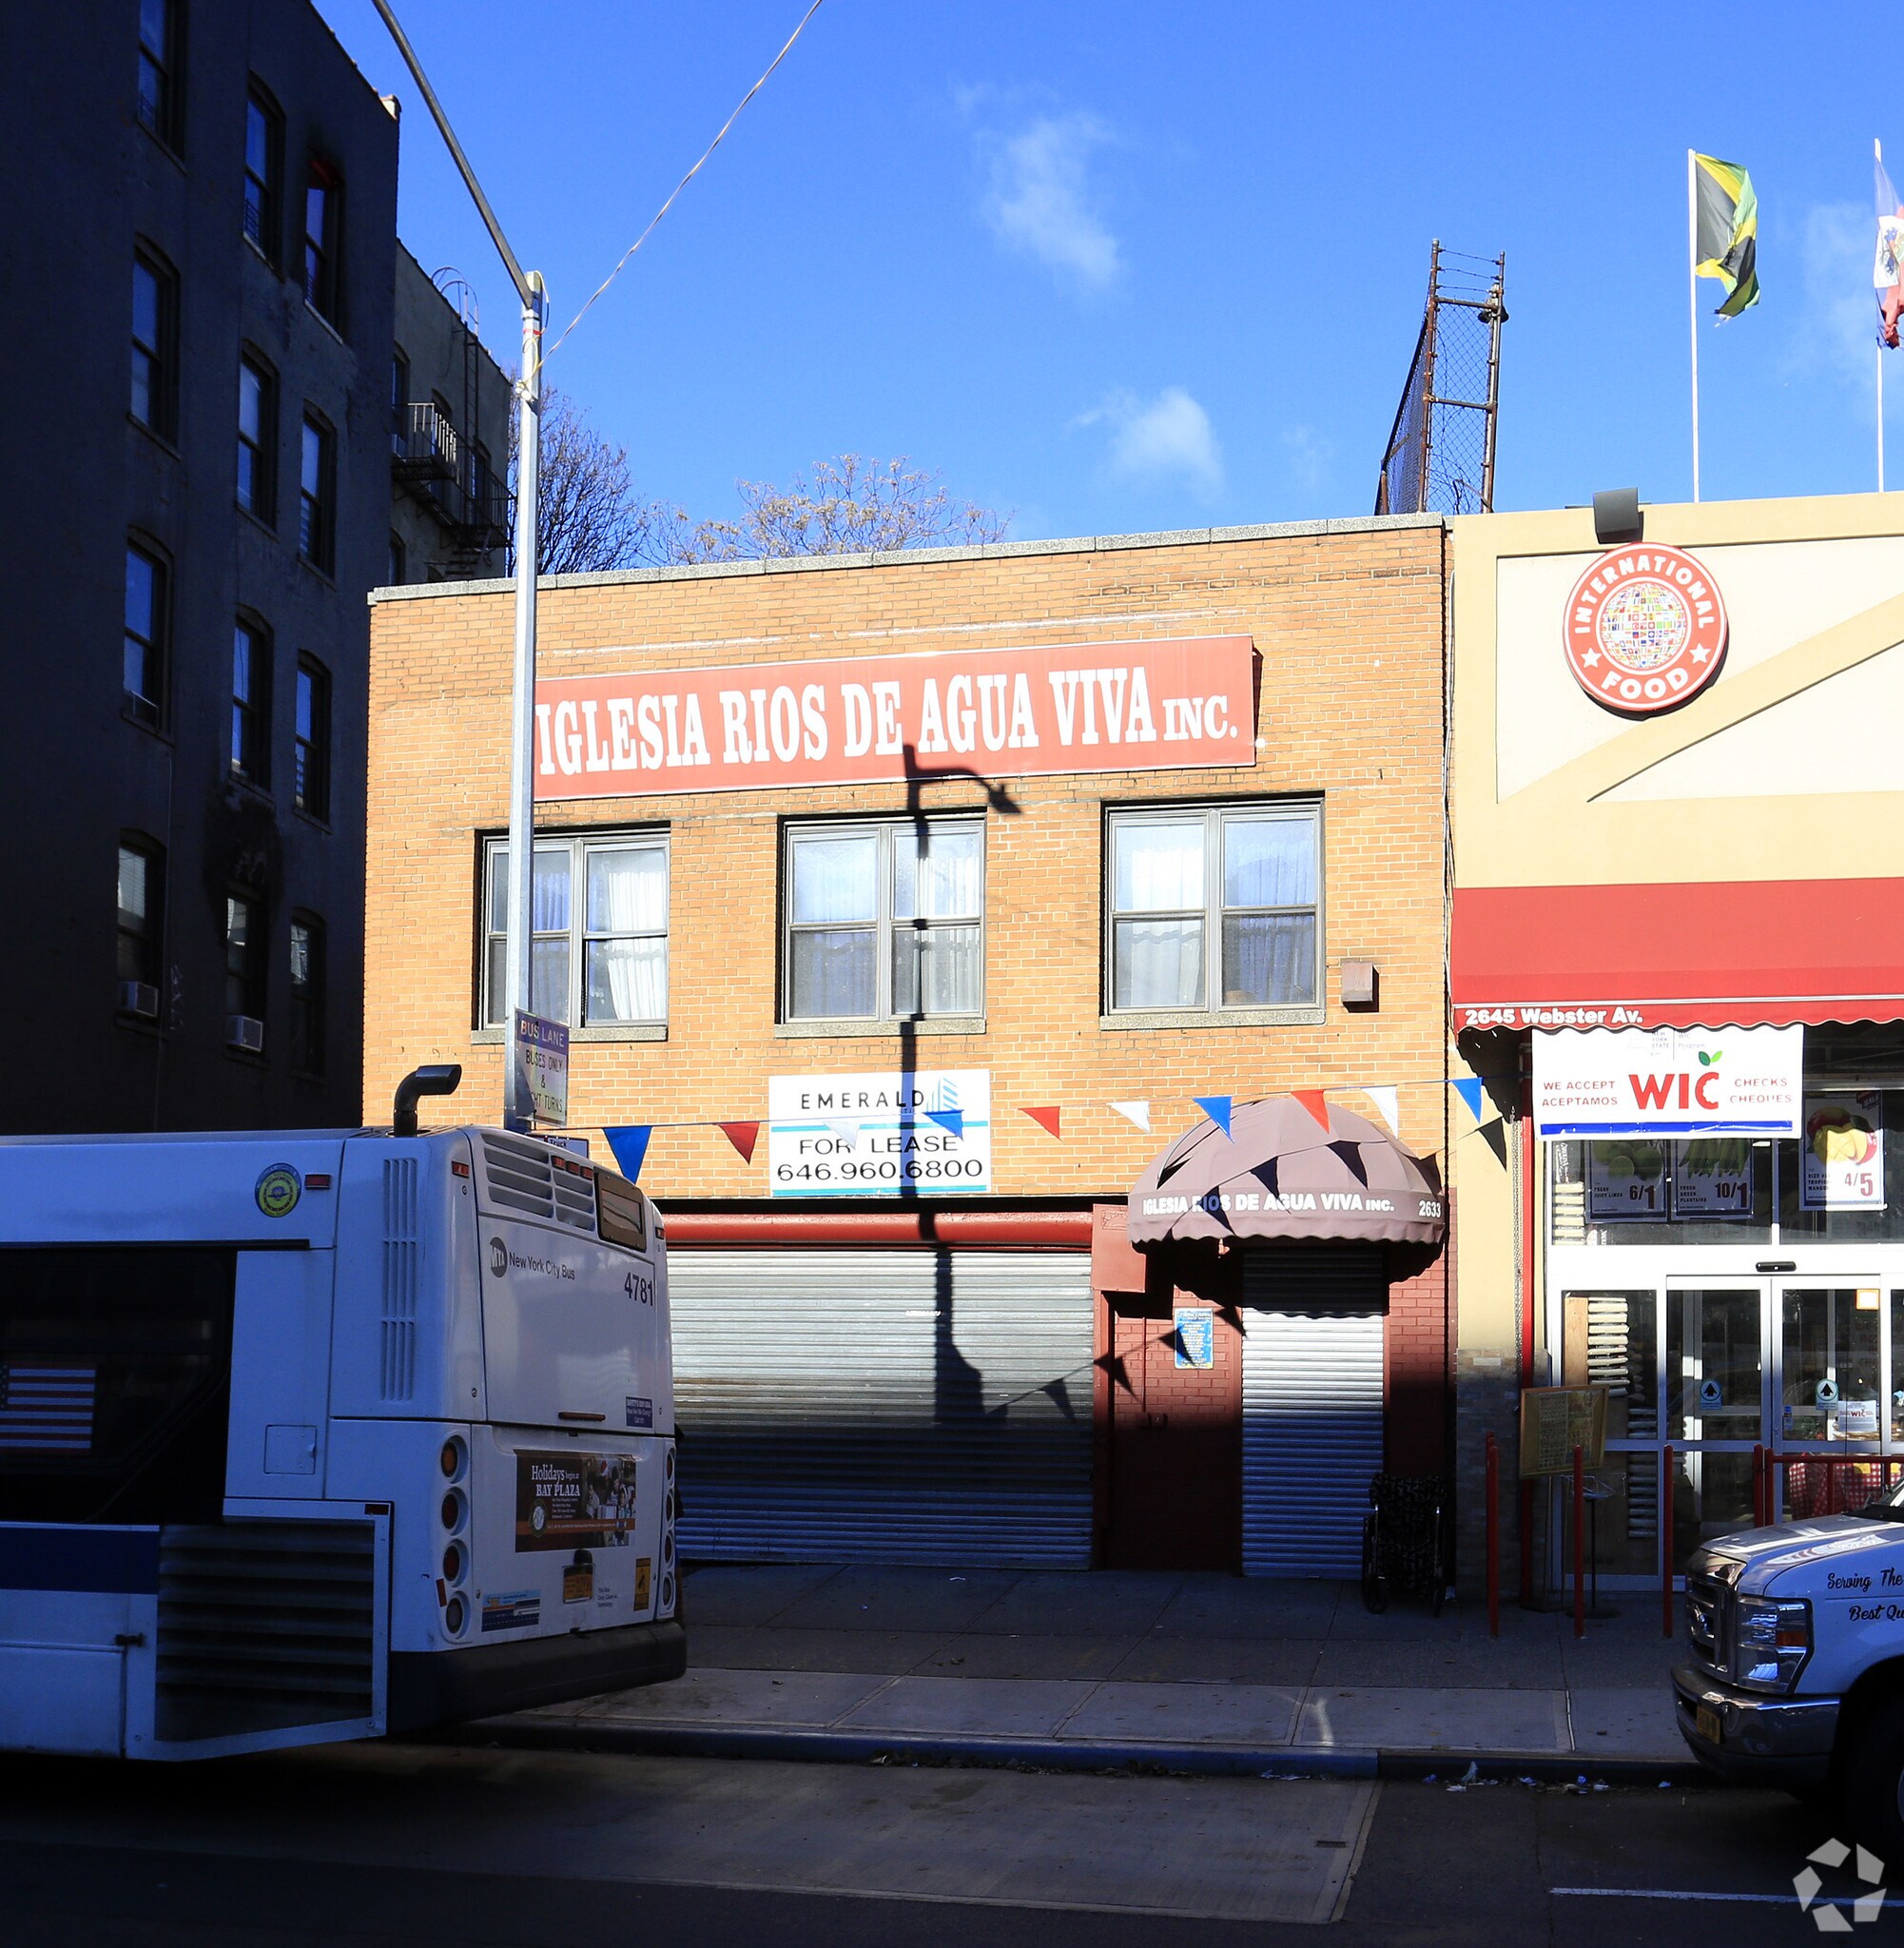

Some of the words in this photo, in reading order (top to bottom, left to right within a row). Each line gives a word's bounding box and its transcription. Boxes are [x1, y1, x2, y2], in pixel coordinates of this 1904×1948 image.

[1574, 555, 1715, 634] INTERNATIONAL
[1600, 667, 1689, 700] FOOD
[535, 690, 710, 776] IGLESIA
[718, 681, 829, 765] RIOS
[841, 679, 903, 757] DE
[917, 672, 1040, 755] AGUA
[1047, 666, 1158, 748] VIVA
[1162, 694, 1238, 742] INC.
[1465, 1008, 1515, 1025] 2645
[1521, 1006, 1607, 1024] Webster
[1611, 1005, 1643, 1023] Av.
[520, 1020, 539, 1039] BUS
[541, 1027, 564, 1048] LANE
[525, 1049, 546, 1069] BUSES
[548, 1056, 563, 1073] ONLY
[540, 1075, 546, 1089] &
[1543, 1081, 1562, 1091] WE
[1565, 1081, 1616, 1090] ACCEPT
[1627, 1071, 1720, 1110] WIC
[1734, 1078, 1788, 1087] CHECKS
[544, 1094, 563, 1113] TURNS
[801, 1090, 925, 1109] EMERALD
[1542, 1096, 1618, 1107] ACEPTAMOS
[799, 1138, 852, 1156] FOR
[870, 1135, 959, 1154] LEASE
[777, 1159, 983, 1181] 646.960.6800
[1715, 1182, 1748, 1208] 10/1
[1844, 1172, 1874, 1197] 4/5
[1142, 1196, 1189, 1216] IGLESIA
[1191, 1194, 1232, 1213] RIOS
[1235, 1194, 1260, 1212] DE
[1263, 1193, 1318, 1212] AGUA
[1320, 1193, 1364, 1212] VIVA
[1366, 1198, 1395, 1212] INC.
[1629, 1184, 1655, 1210] 6/1
[1418, 1199, 1442, 1218] 2633
[509, 1251, 527, 1269] New
[527, 1256, 545, 1274] York
[545, 1260, 561, 1279] City
[561, 1264, 575, 1280] Bus
[624, 1272, 654, 1306] 4781
[531, 1463, 565, 1485] Holidays
[535, 1483, 553, 1497] BAY
[554, 1483, 581, 1497] PLAZA
[1827, 1572, 1873, 1593] Serving
[1880, 1566, 1904, 1587] The
[1848, 1604, 1886, 1622] Best
